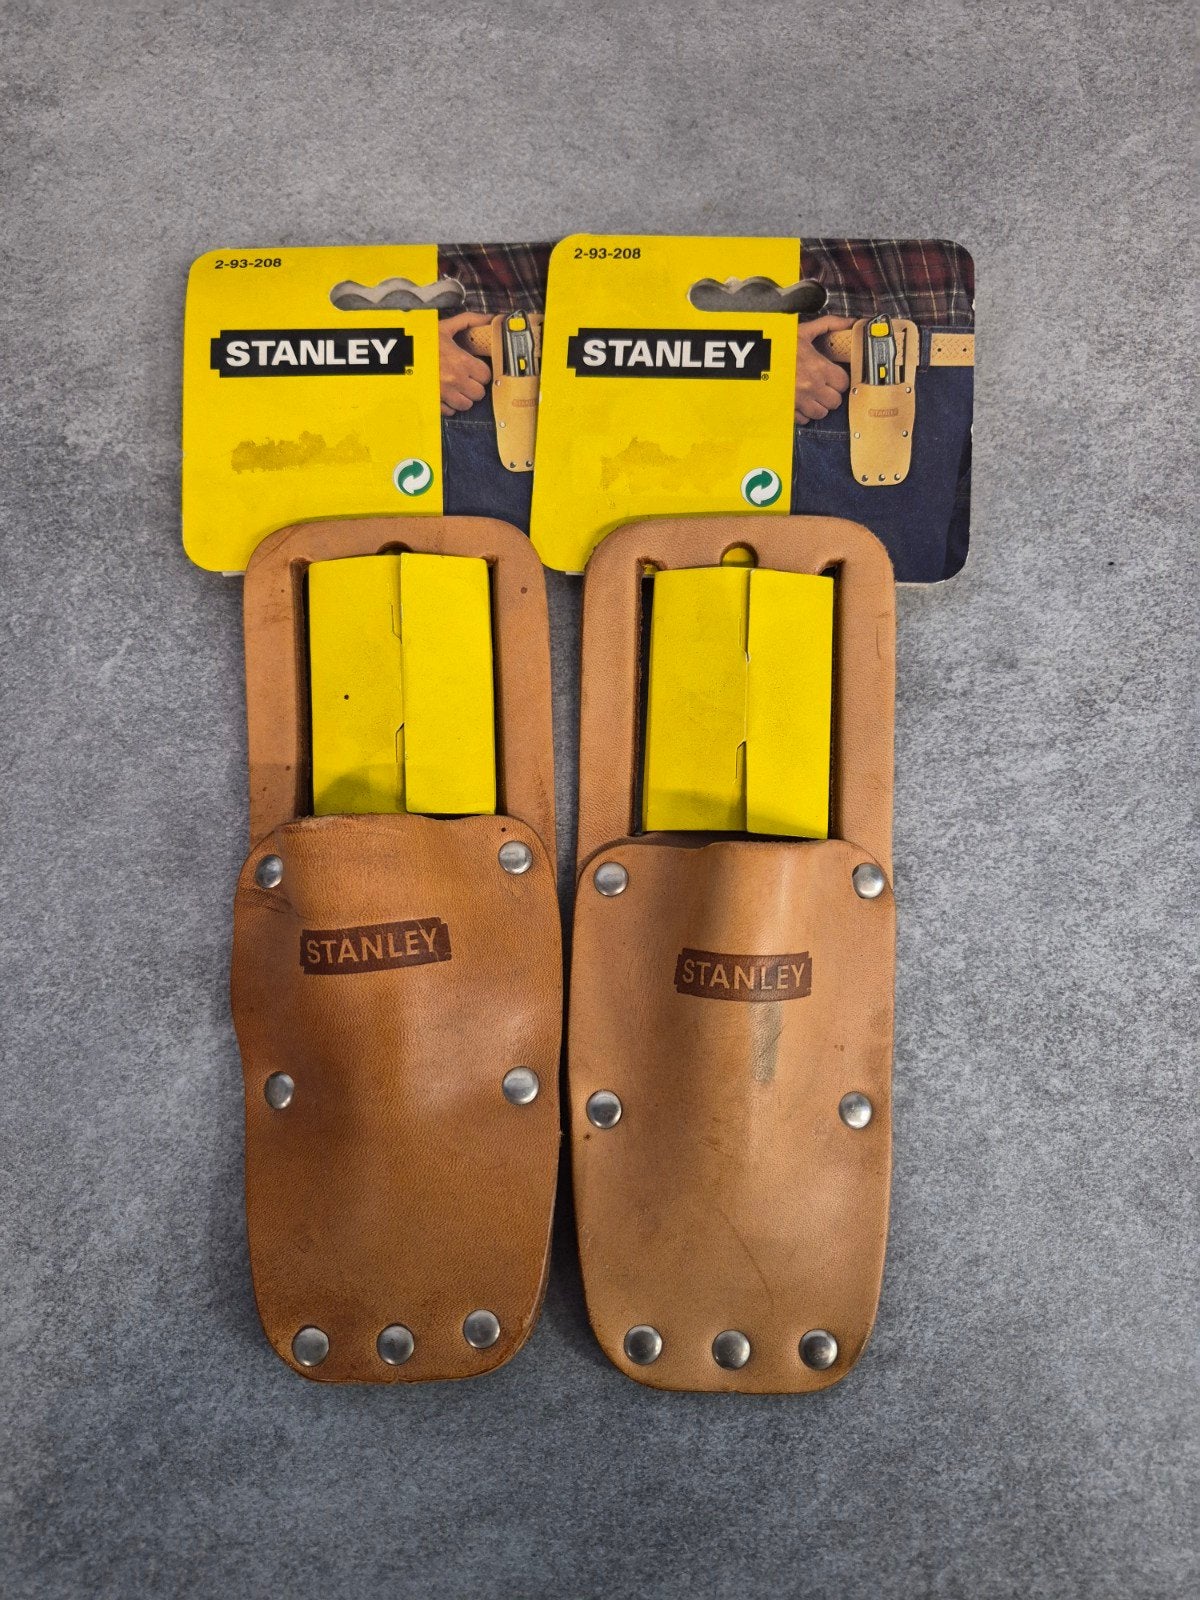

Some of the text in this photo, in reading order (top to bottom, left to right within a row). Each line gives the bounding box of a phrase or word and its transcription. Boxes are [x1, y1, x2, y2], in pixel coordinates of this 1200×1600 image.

[215, 258, 282, 269] 2-93-208
[573, 248, 642, 260] 2-93-208
[226, 339, 398, 367] STANLEY
[582, 339, 756, 369] STANLEY
[306, 928, 437, 964] STANLEY
[682, 958, 805, 990] STANLEY
